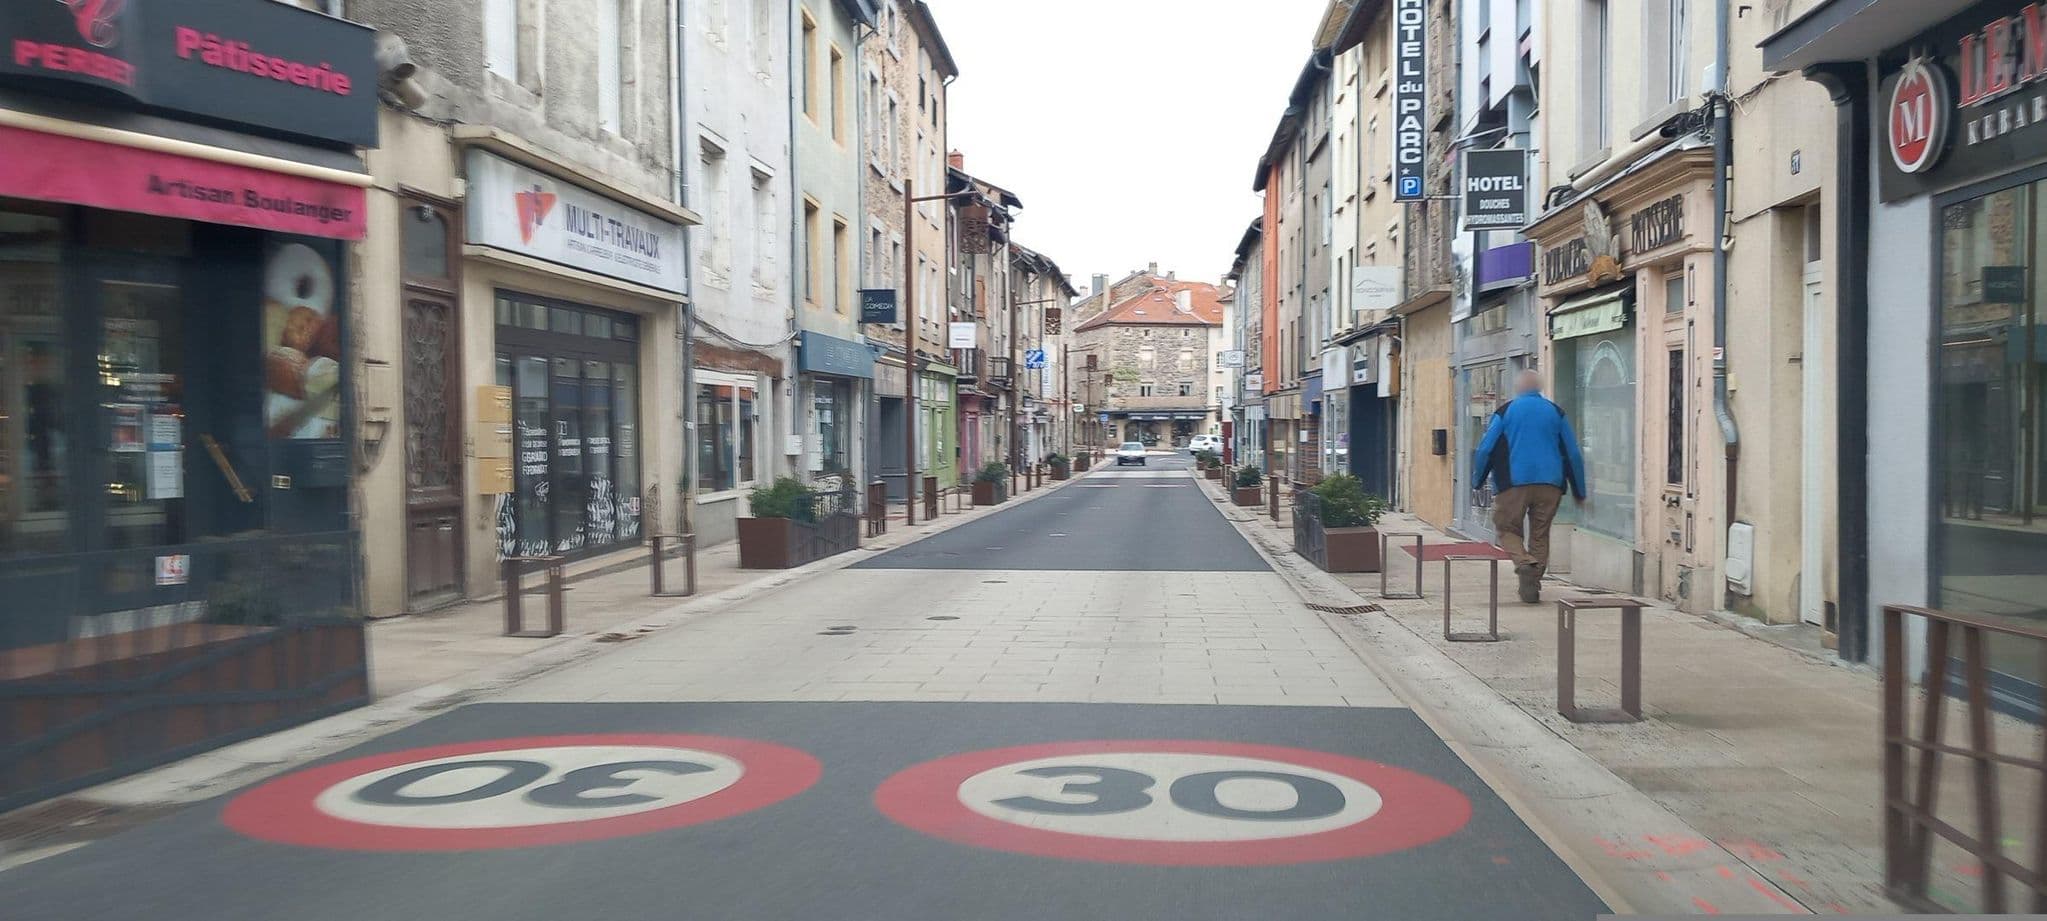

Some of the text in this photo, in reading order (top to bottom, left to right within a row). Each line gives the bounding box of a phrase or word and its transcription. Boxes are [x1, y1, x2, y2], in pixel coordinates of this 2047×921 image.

[174, 25, 352, 97] Pâtisserie
[1399, 83, 1423, 94] du
[1399, 99, 1423, 164] PARC
[1899, 94, 1927, 149] M
[147, 175, 352, 224] Artisan Boulanger
[1467, 176, 1523, 192] HOTEL
[566, 203, 661, 260] MULTI-TRAVAUX
[356, 759, 716, 809] 30
[990, 765, 1346, 822] 30
